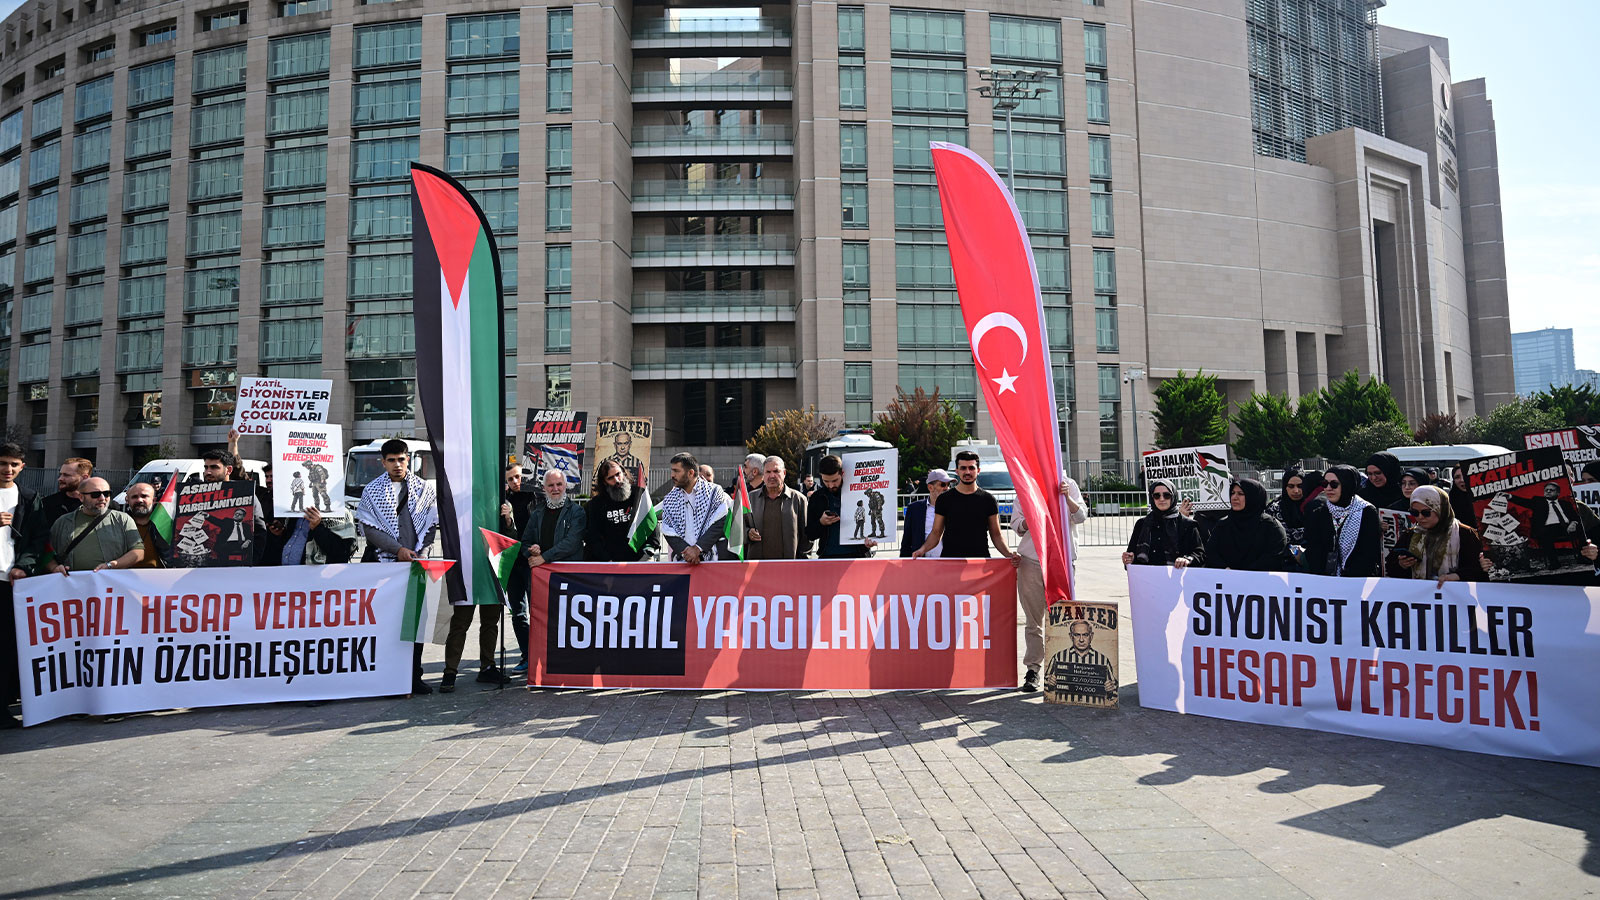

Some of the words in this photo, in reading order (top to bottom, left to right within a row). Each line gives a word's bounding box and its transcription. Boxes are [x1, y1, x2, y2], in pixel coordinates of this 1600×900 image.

[255, 379, 282, 388] KATİL
[240, 386, 329, 400] SİYONİSTLER
[251, 400, 295, 410] KADIN
[298, 401, 315, 410] VE
[240, 410, 321, 422] ÇOCUKLARI
[533, 410, 576, 422] ASRIN
[237, 423, 272, 434] ÖLDÜ
[531, 420, 583, 433] KATİLİ
[599, 420, 651, 438] WANTED
[288, 431, 327, 440] DOKUNULMAZ
[526, 433, 586, 443] YARGILANIYOR!
[1525, 431, 1577, 450] İSRAİL
[282, 453, 334, 463] VERECEKSİNİZ!
[296, 446, 321, 454] HESAP
[1145, 456, 1160, 467] BİR
[1162, 453, 1194, 466] HALKIN
[1467, 453, 1516, 476] ASRIN
[1469, 459, 1534, 487] KATİLİ
[180, 481, 223, 496] ASRIN
[1471, 466, 1563, 497] YARGILANIYOR!
[178, 496, 253, 513] YARGILANIYOR!
[179, 488, 233, 505] KATİLİ
[26, 587, 129, 647] İSRAİL
[141, 592, 243, 635] HESAP
[253, 588, 377, 631] VERECEK
[557, 583, 679, 650] İSRAİL
[692, 594, 992, 651] YARGILANIYOR!
[1049, 606, 1118, 630] WANTED
[1192, 583, 1348, 645] SİYONİST
[1360, 593, 1535, 658] KATİLLER
[31, 639, 144, 697] FİLİSTİN
[154, 634, 376, 684] ÖZGÜRLEŞECEK!
[1193, 646, 1317, 707] HESAP
[1330, 657, 1541, 732] VERECEK!
